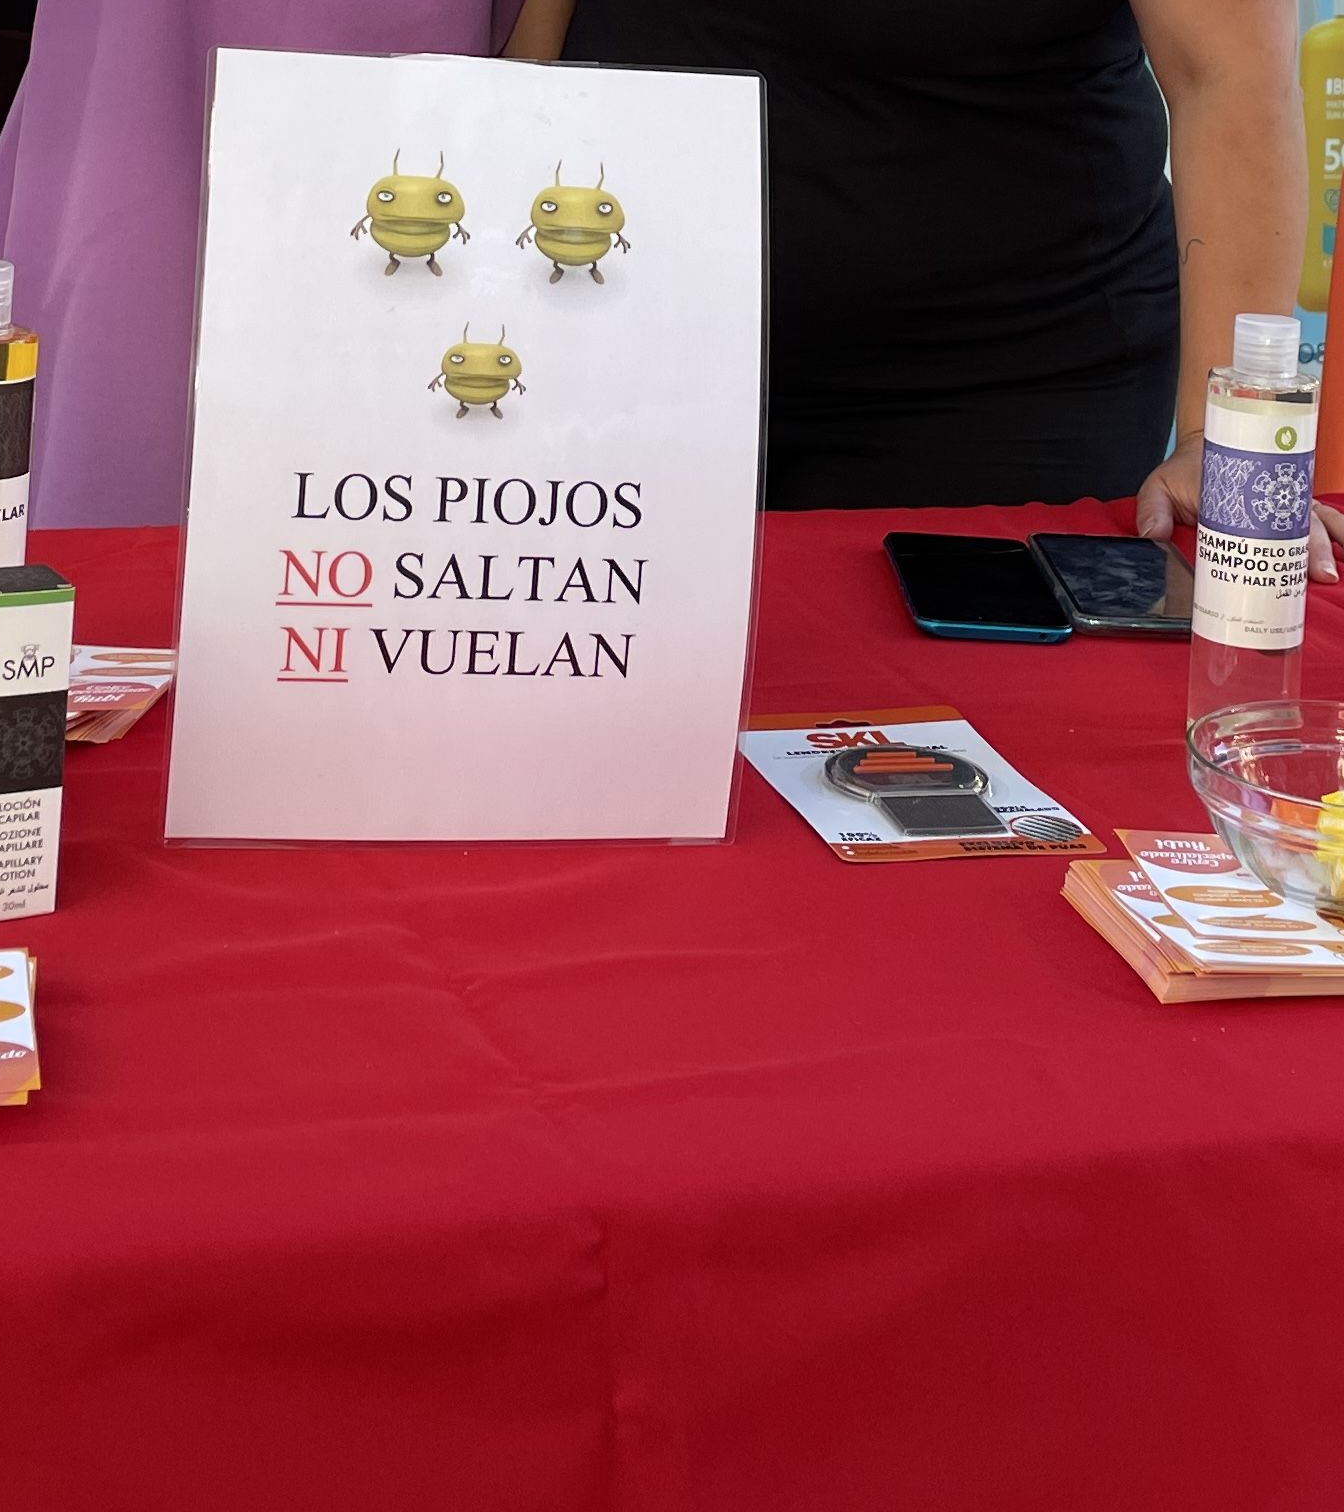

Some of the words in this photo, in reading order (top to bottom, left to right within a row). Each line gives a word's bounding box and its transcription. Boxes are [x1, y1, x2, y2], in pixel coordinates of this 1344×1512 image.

[292, 472, 414, 523] LOS
[433, 476, 644, 530] PIOJOS
[1199, 546, 1269, 572] SHAMPOO
[1253, 547, 1285, 558] PELO
[278, 548, 374, 600] NO
[393, 552, 648, 606] SALTAN
[1211, 569, 1238, 583] OILY
[1243, 576, 1276, 586] HAIR
[278, 627, 348, 676] NI
[371, 629, 636, 679] VUELAN
[2, 656, 55, 680] SMP
[0, 797, 41, 812] LOCIÓN
